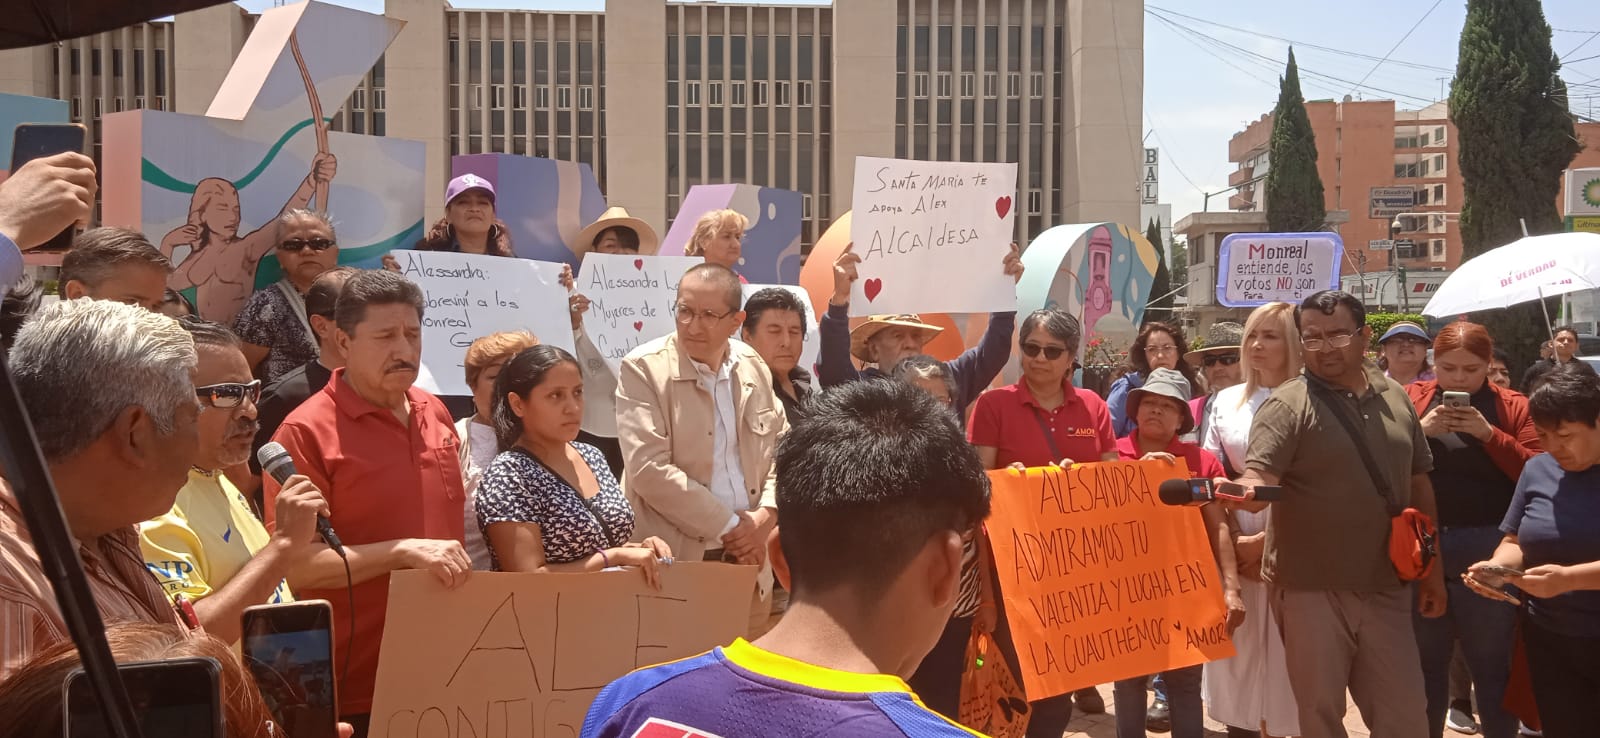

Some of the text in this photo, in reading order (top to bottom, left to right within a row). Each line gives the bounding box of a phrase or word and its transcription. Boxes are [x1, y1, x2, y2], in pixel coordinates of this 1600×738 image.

[1145, 149, 1157, 204] BAL
[1248, 240, 1308, 260] Monreal
[590, 264, 659, 291] Alessandra
[1296, 260, 1313, 275] los
[1234, 276, 1316, 290] votos NO son
[424, 290, 519, 309] obreviví a los
[591, 299, 635, 329] Mujeres
[641, 301, 657, 318] de
[1040, 464, 1156, 515] ALESANDRA
[1012, 520, 1149, 585] ADMIRAMOS TU
[146, 560, 193, 579] NP
[1029, 561, 1207, 631] VALENTIA Y LUCHA EN
[1029, 642, 1060, 676] LA
[387, 698, 577, 738] CONTIG
